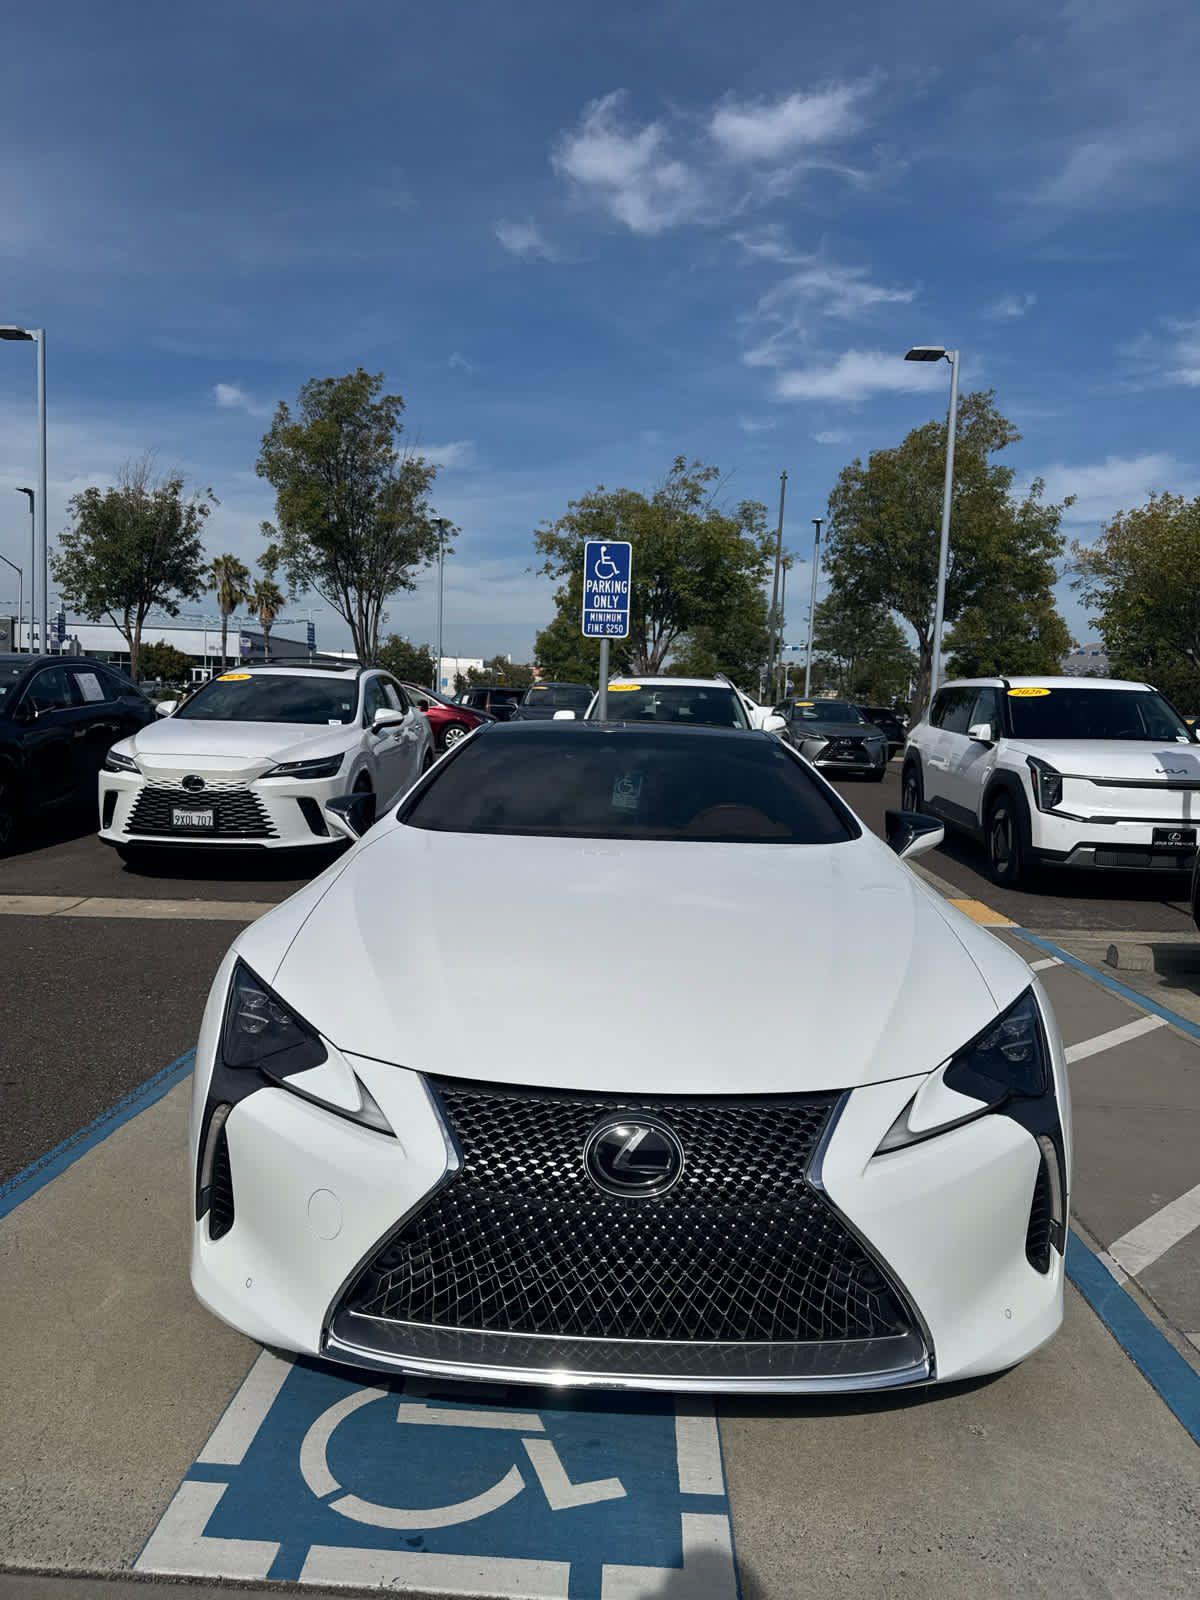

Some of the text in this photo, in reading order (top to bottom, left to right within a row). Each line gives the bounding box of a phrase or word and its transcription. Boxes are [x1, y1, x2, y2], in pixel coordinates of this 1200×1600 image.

[586, 580, 627, 593] PARKING
[593, 595, 619, 608] ONLY
[590, 612, 622, 622] MINIMUM
[587, 623, 624, 633] FINE $250
